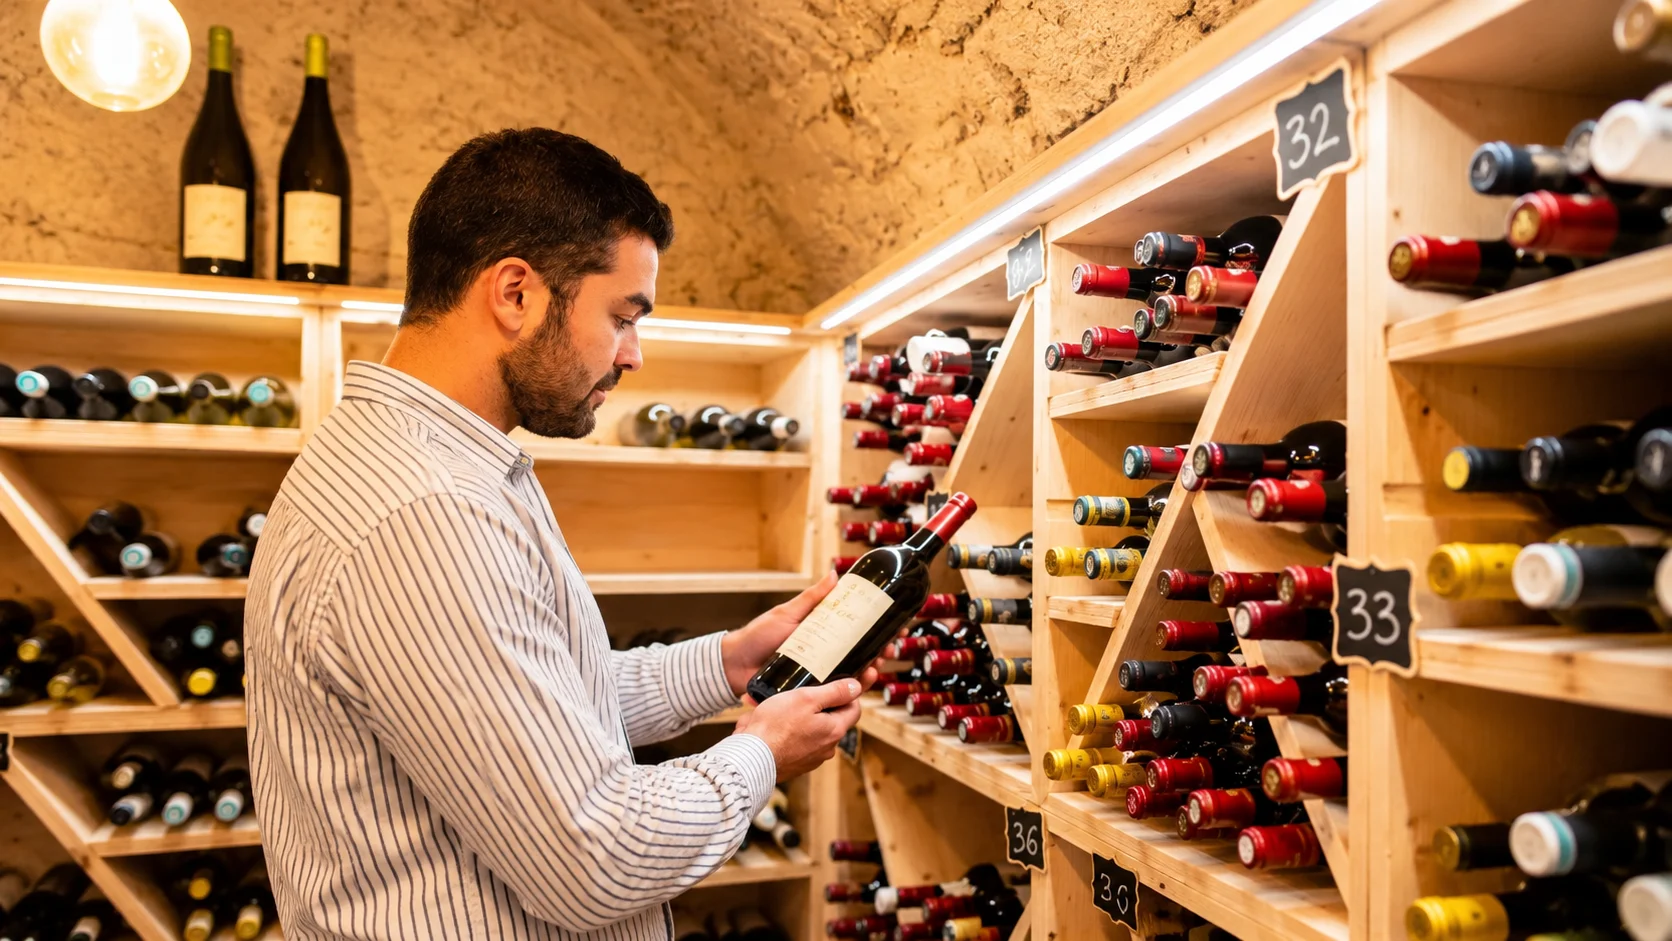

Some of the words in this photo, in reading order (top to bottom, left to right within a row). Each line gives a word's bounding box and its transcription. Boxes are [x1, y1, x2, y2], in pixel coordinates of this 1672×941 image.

[1285, 102, 1340, 170] 32
[1347, 588, 1401, 646] 33
[1013, 821, 1038, 856] 36
